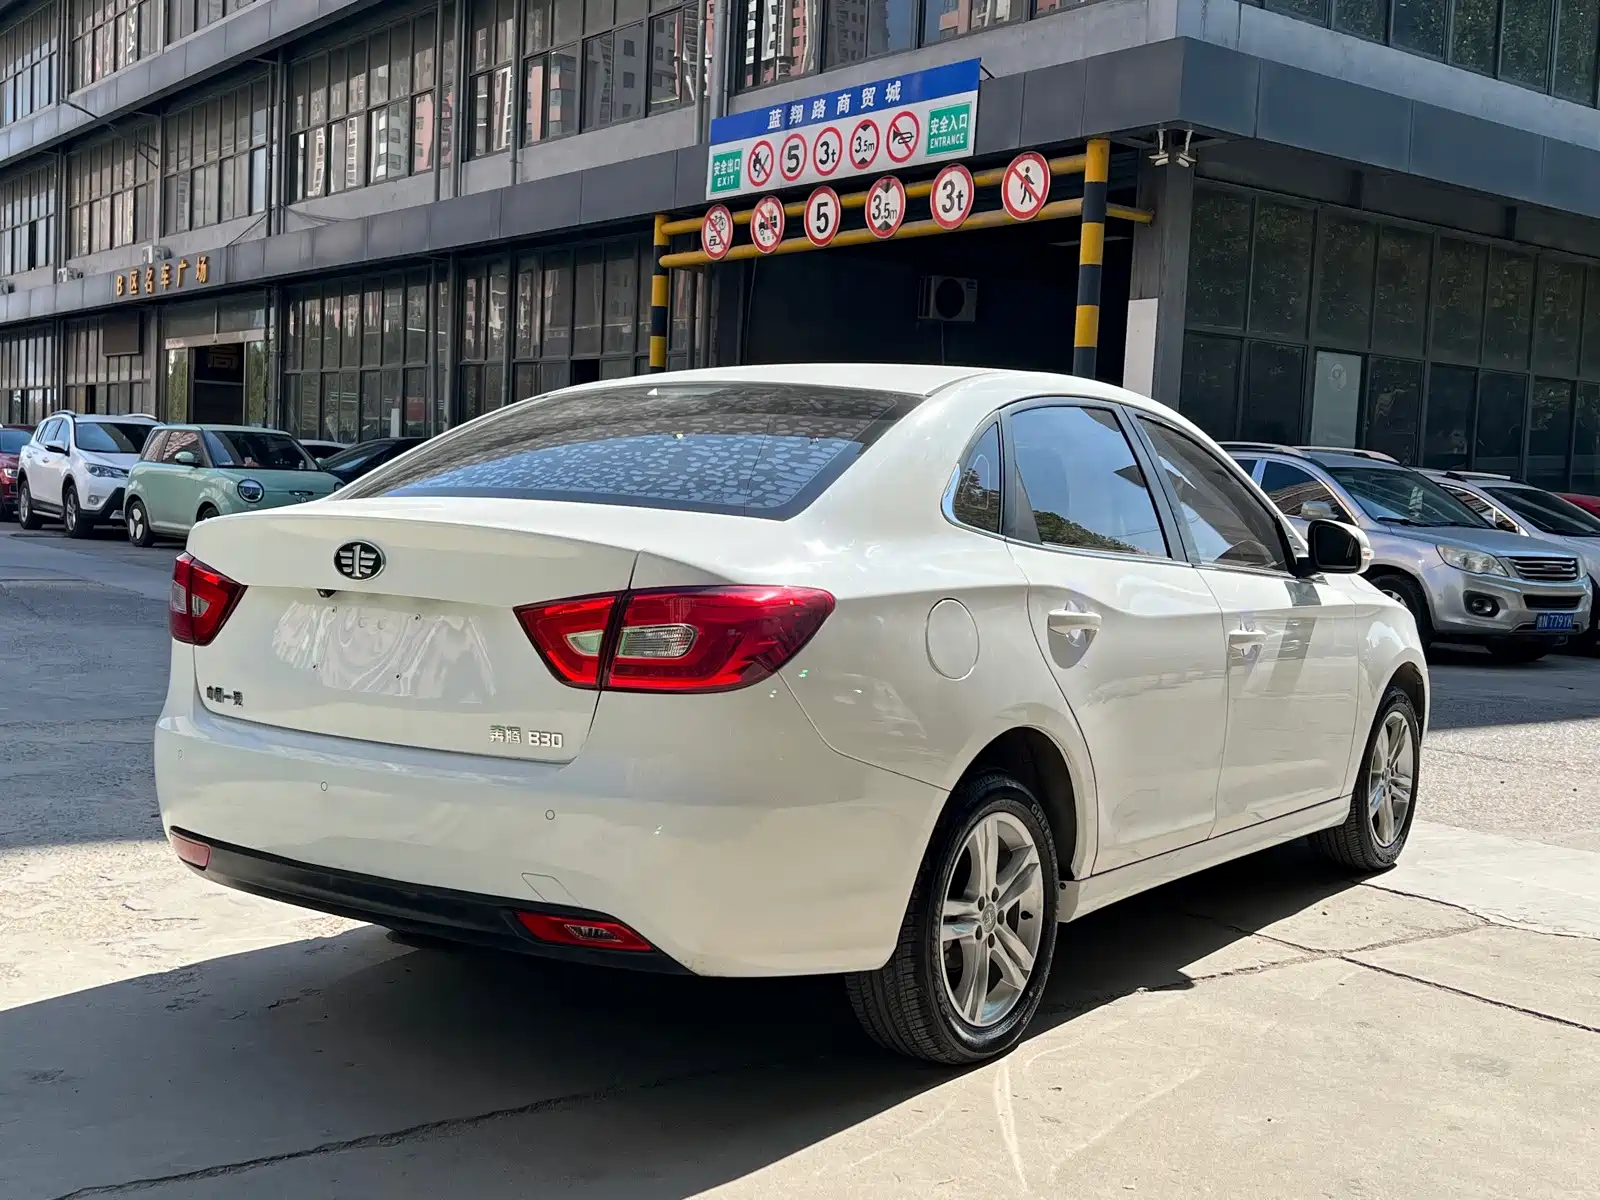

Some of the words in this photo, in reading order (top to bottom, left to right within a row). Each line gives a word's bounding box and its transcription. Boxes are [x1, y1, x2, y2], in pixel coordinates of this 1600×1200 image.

[767, 80, 902, 129] 蓝翔路商贸城
[930, 112, 968, 135] 安全入口
[819, 140, 836, 165] 3t
[854, 135, 875, 154] 3.5m
[930, 134, 964, 148] ENTRANCE
[713, 158, 741, 176] 安全出口
[787, 144, 800, 173] 5
[717, 175, 735, 187] EXIT
[871, 194, 898, 220] 3.5m
[941, 180, 964, 213] 3t
[815, 201, 829, 233] 5
[116, 255, 209, 296] B区名车广场
[489, 724, 521, 744] 奔腾
[528, 730, 563, 749] B30
